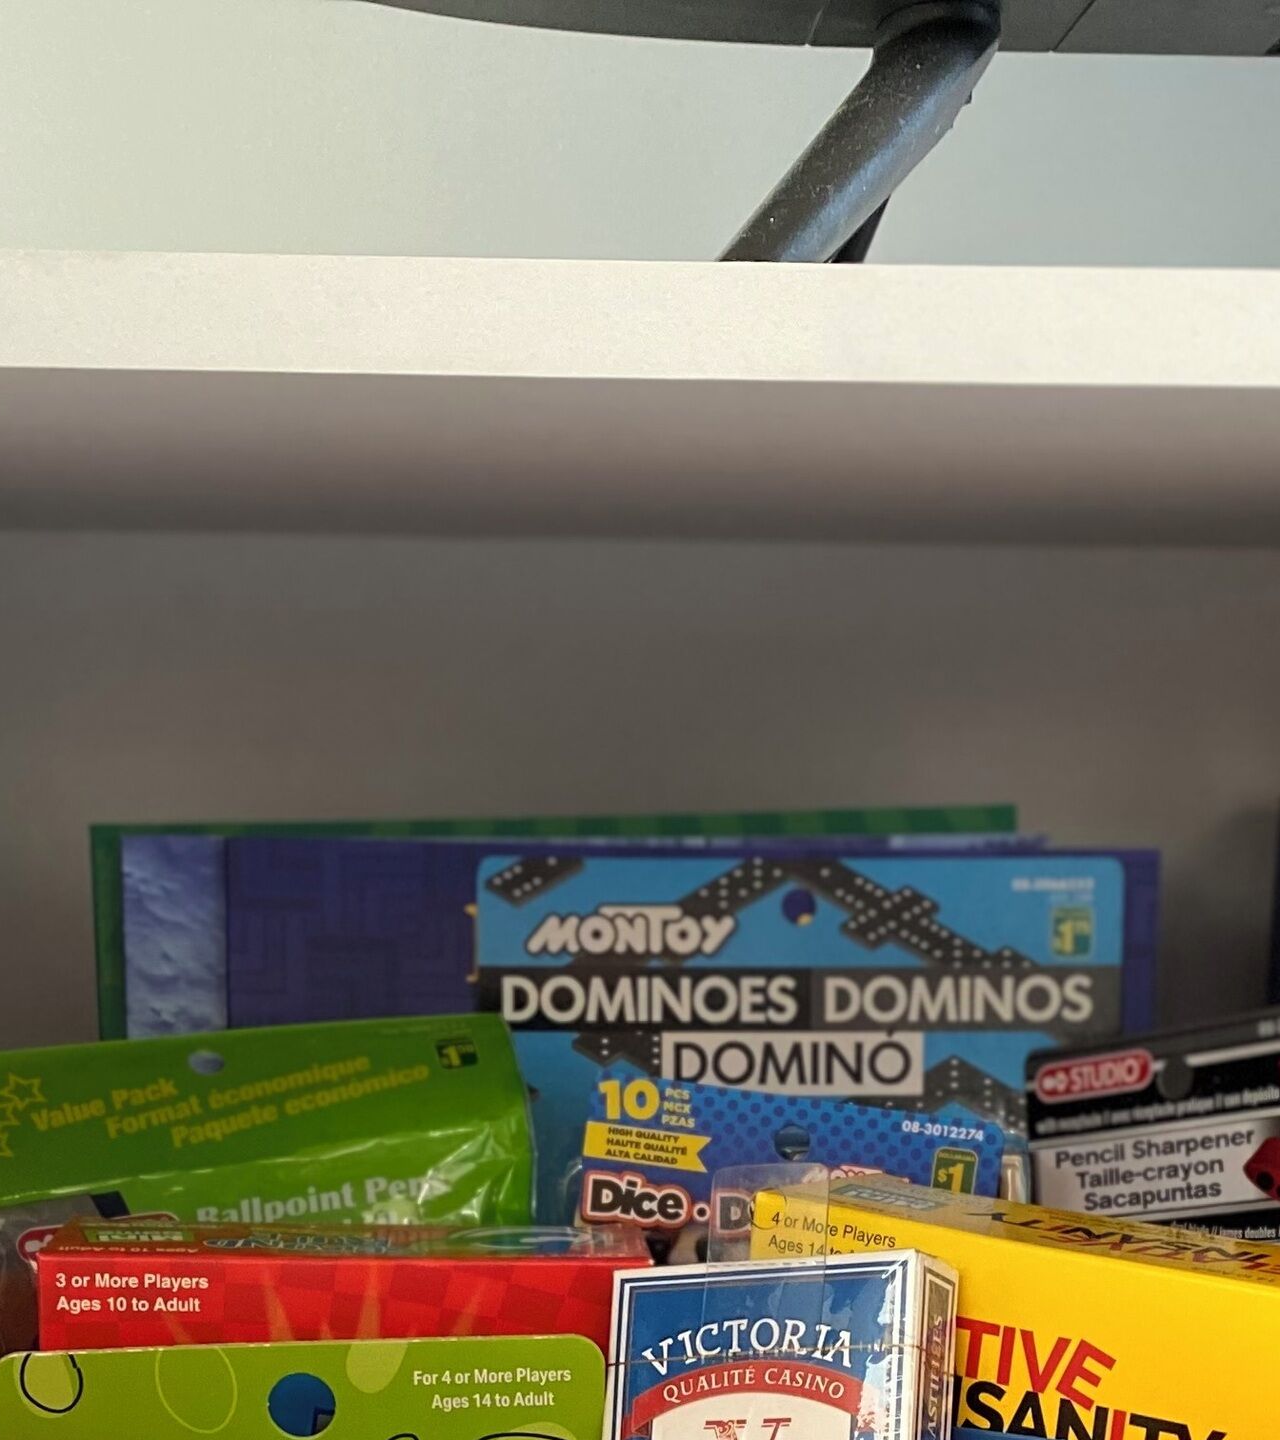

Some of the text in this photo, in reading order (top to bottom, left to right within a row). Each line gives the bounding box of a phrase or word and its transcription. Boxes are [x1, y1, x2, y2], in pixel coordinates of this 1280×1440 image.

[526, 904, 734, 955] MONTOY
[501, 974, 1093, 1023] DOMINOES DOMINOS
[673, 1027, 913, 1085] DOMINÓ
[1070, 1058, 1140, 1092] STUDIO
[30, 1077, 180, 1131] Value Pack
[105, 1056, 371, 1140] Format économique
[170, 1064, 431, 1149] Paquete económico
[598, 1079, 690, 1120] 10 PCS
[608, 1127, 680, 1143] HIGH QUALITY
[661, 1114, 696, 1128] PZAS
[901, 1118, 985, 1142] 08-3012274
[605, 1149, 678, 1165] ALTA CALIDAD
[606, 1138, 688, 1155] HAUTE QUALITÉ
[1055, 1129, 1256, 1170] Pencil Sharpener
[1076, 1156, 1226, 1191] Taille-crayon
[197, 1181, 358, 1224] Ballpoint
[586, 1173, 688, 1224] Dice
[1084, 1179, 1224, 1213] Sacapuntas
[769, 1234, 804, 1254] Ages
[809, 1243, 824, 1256] 14
[771, 1211, 896, 1249] 4 or More Players
[55, 1273, 209, 1292] 3 or More Players
[56, 1296, 201, 1314] Ages 10 to Adult
[641, 1318, 853, 1376] VICTORIA
[956, 1315, 1117, 1410] TIVE
[413, 1368, 572, 1386] For 4 or More Players
[663, 1366, 845, 1404] QUALITÉ CASINO
[431, 1391, 555, 1412] Ages 14 to Adult
